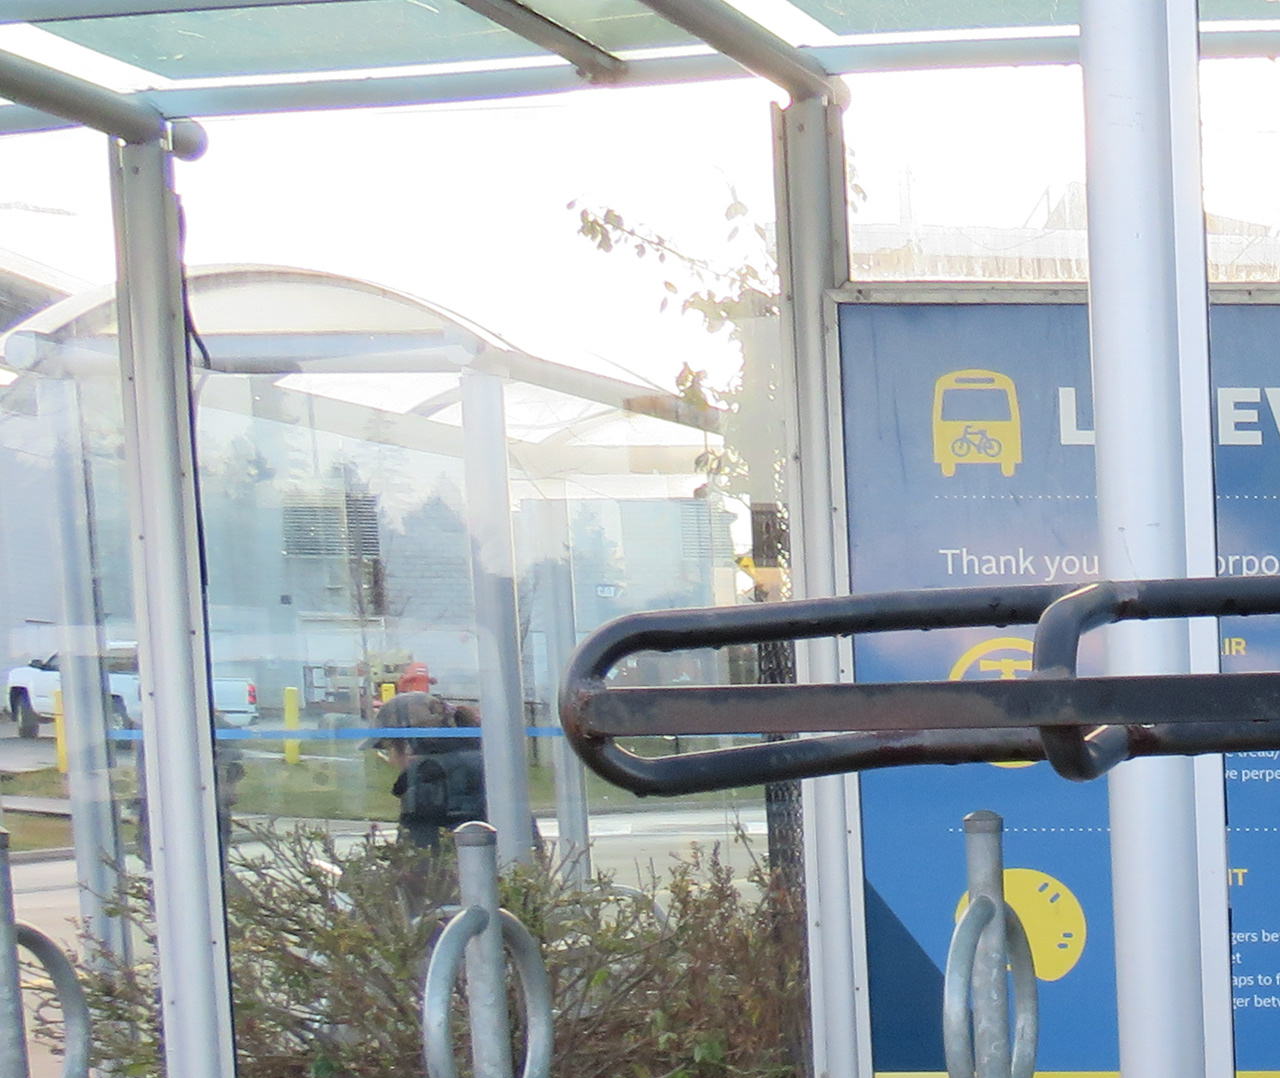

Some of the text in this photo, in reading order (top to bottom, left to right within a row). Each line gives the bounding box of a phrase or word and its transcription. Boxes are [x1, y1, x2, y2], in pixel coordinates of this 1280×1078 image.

[939, 548, 1036, 575] Thank
[1045, 555, 1100, 582] you
[1257, 974, 1273, 986] to
